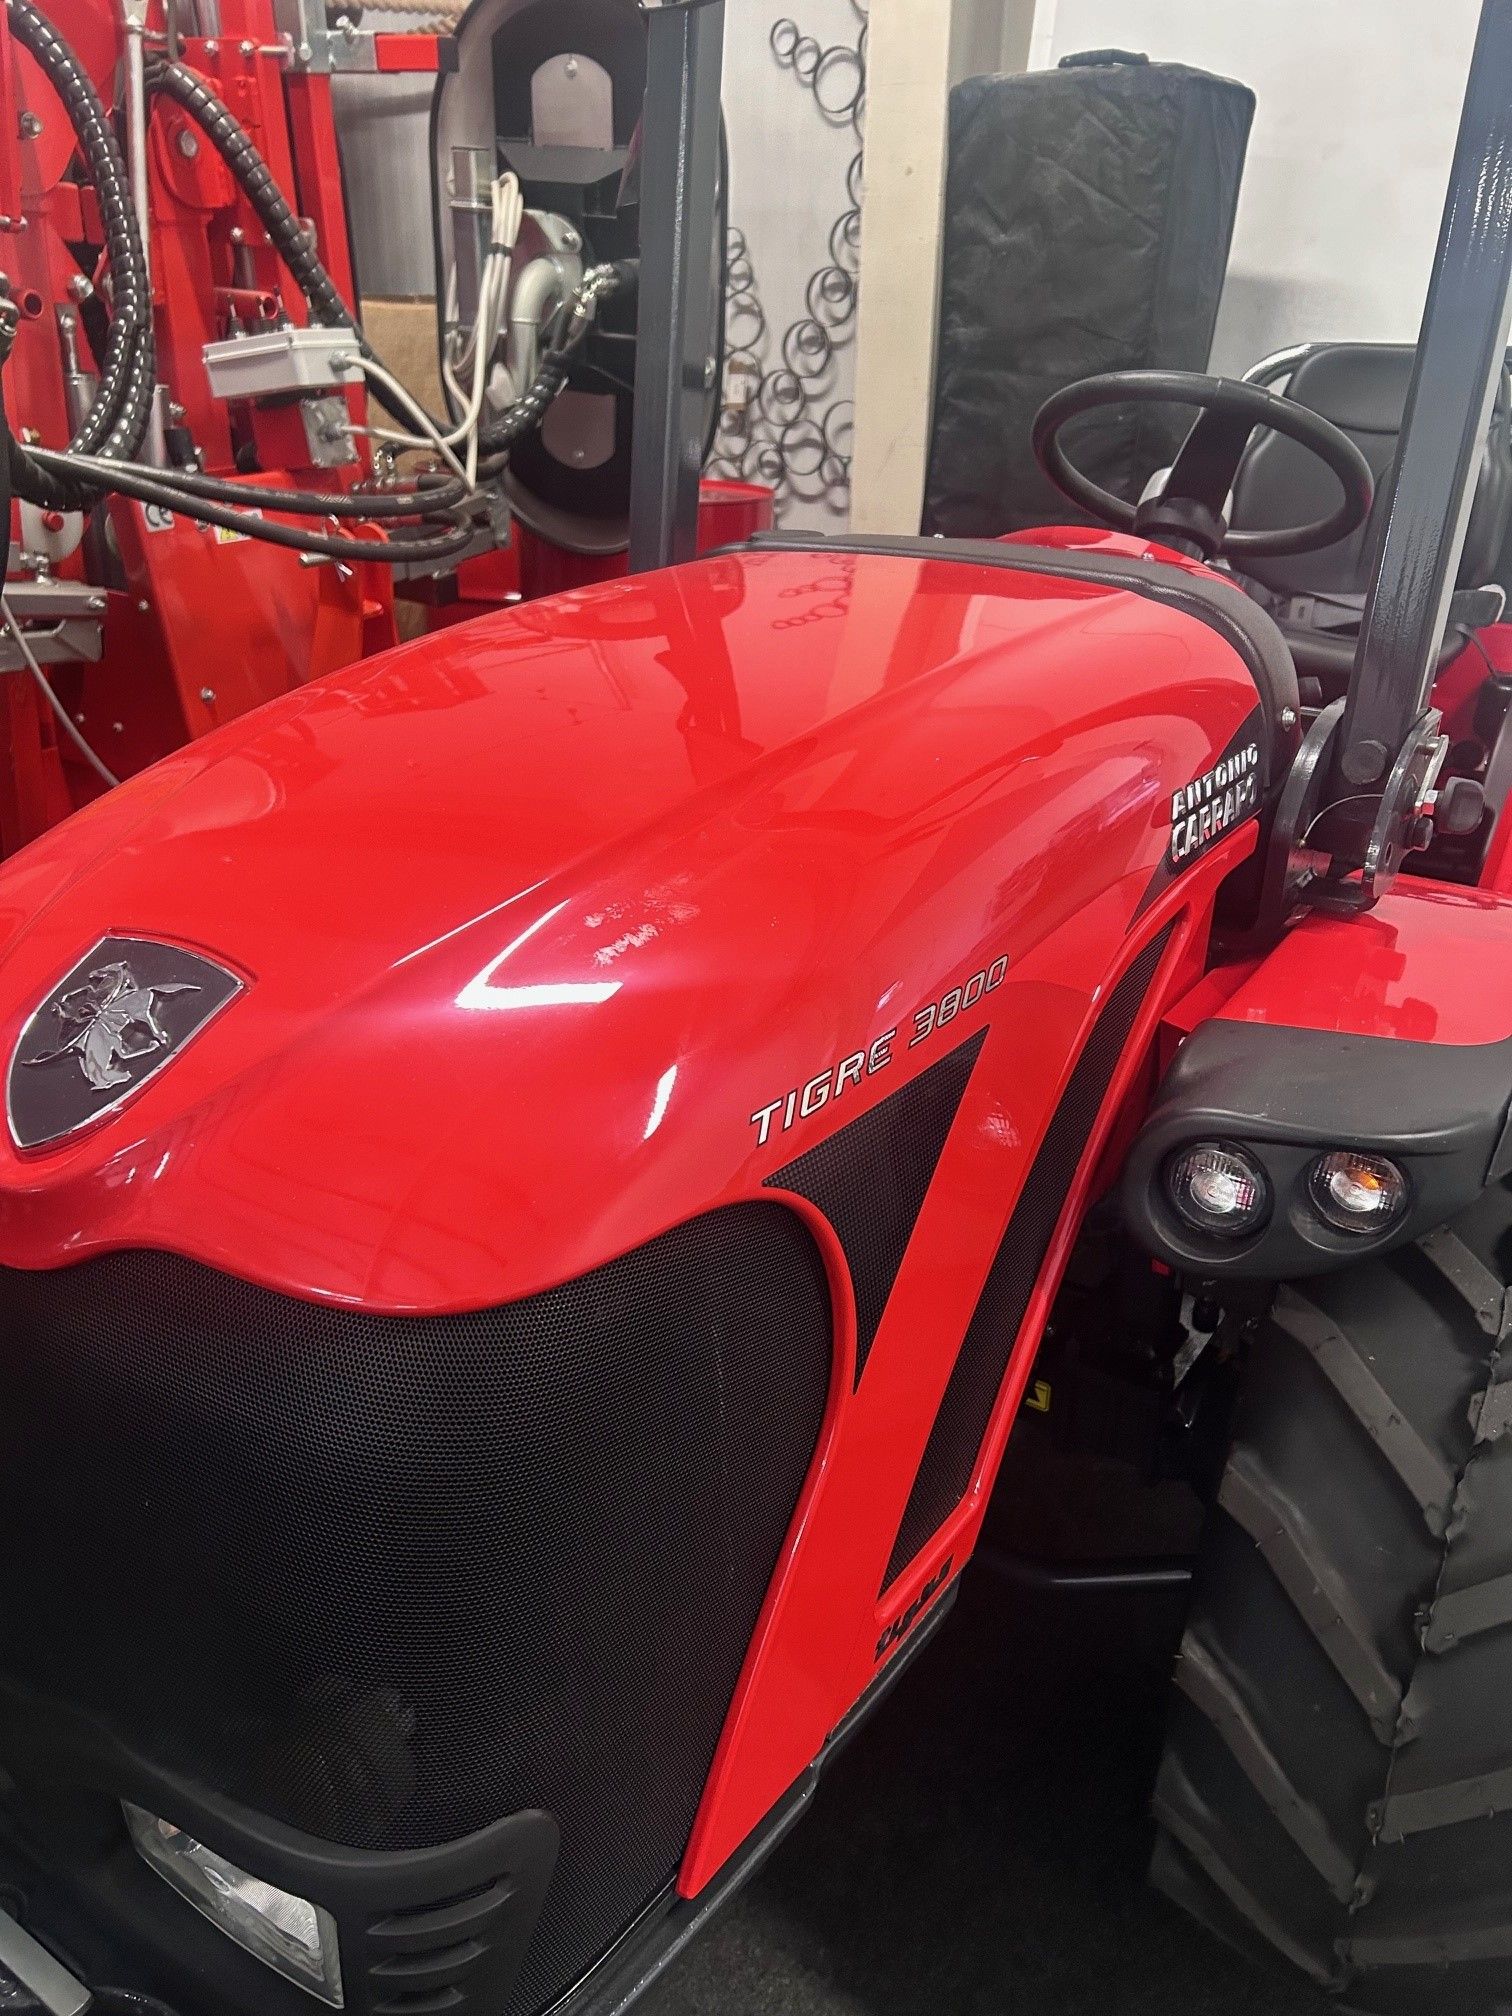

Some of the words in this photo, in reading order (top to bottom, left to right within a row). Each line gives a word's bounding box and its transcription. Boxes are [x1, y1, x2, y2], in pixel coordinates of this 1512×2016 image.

[1172, 743, 1258, 820] ANTONIO
[750, 1029, 897, 1148] TIGRE
[908, 954, 1009, 1049] 3800
